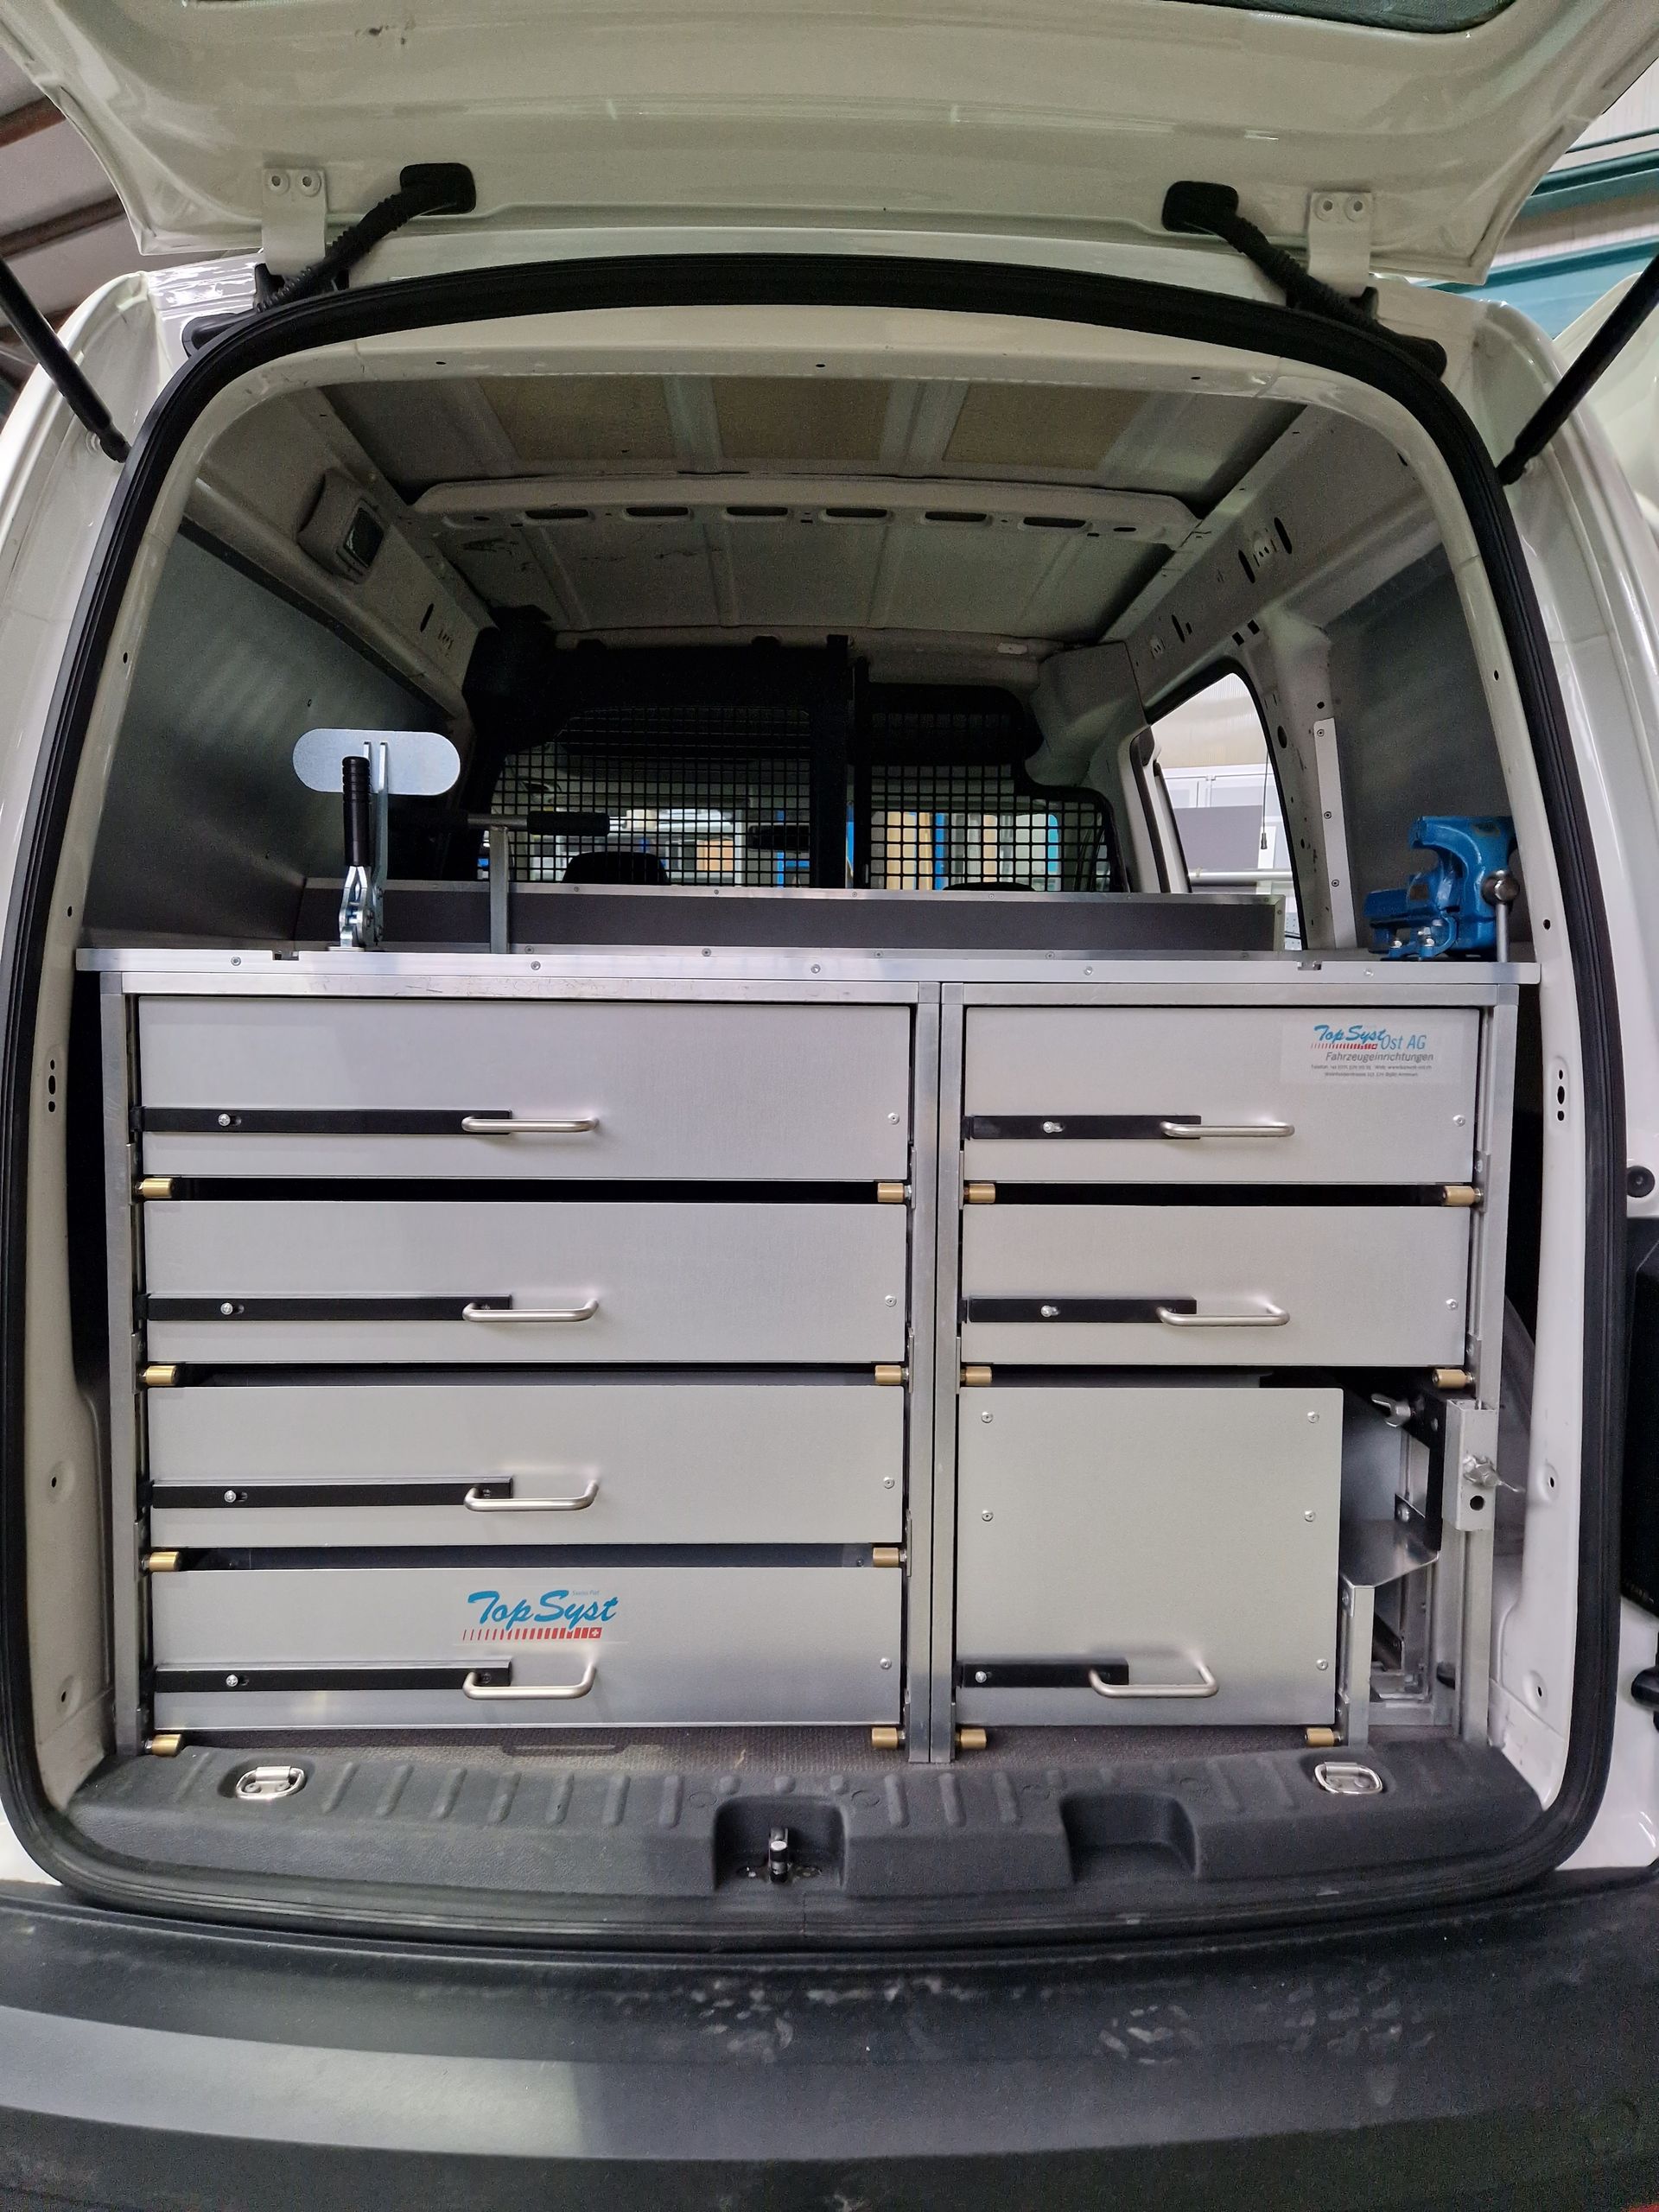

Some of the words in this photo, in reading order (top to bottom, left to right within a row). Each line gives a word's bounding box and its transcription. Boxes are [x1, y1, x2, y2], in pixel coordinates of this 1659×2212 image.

[1381, 1034, 1404, 1050] Ost
[1407, 1034, 1427, 1050] AG
[1325, 1052, 1434, 1064] Fahrzeugeinrichtungen
